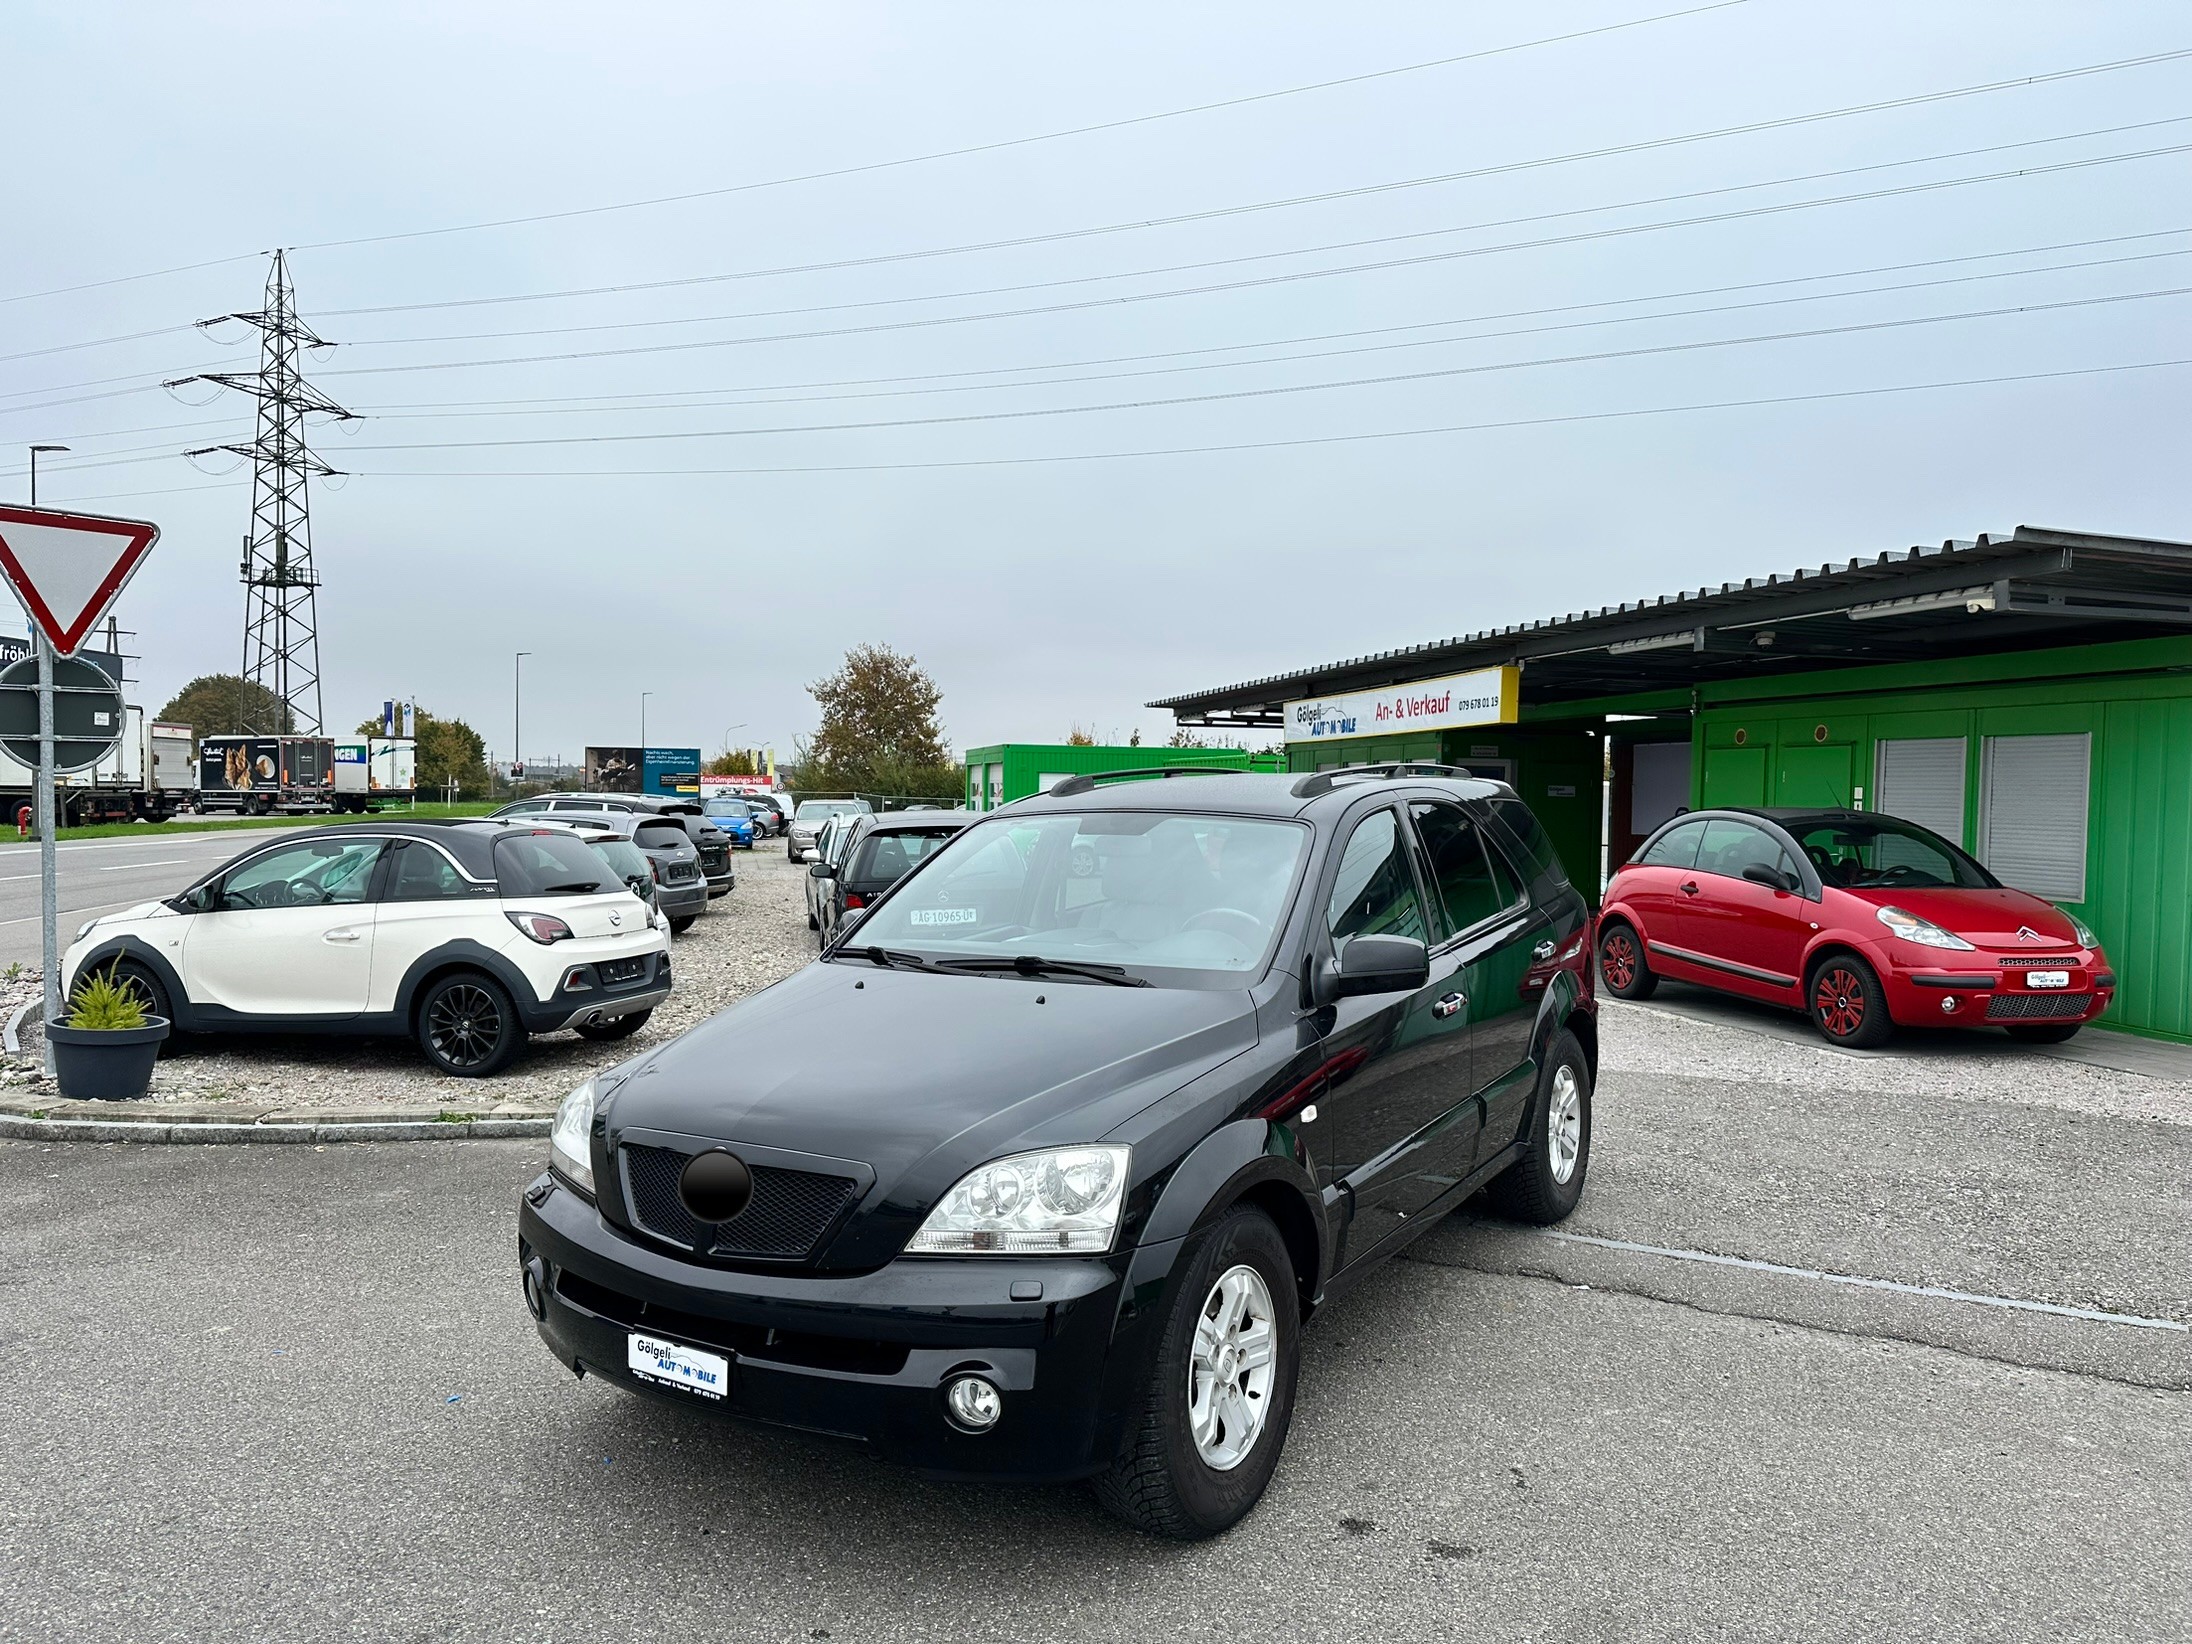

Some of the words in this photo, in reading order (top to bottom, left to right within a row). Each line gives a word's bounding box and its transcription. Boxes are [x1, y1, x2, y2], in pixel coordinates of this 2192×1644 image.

[1297, 703, 1321, 726] Gölgeli
[1376, 702, 1393, 721] An-
[1396, 698, 1404, 719] &
[1406, 690, 1451, 717] Verkauf
[1459, 701, 1469, 711] 079
[1470, 698, 1481, 709] 678
[1482, 697, 1490, 708] 01
[1491, 696, 1499, 707] 19
[637, 1340, 671, 1359] Gölgeli
[657, 1359, 716, 1384] AUTOMOBILE
